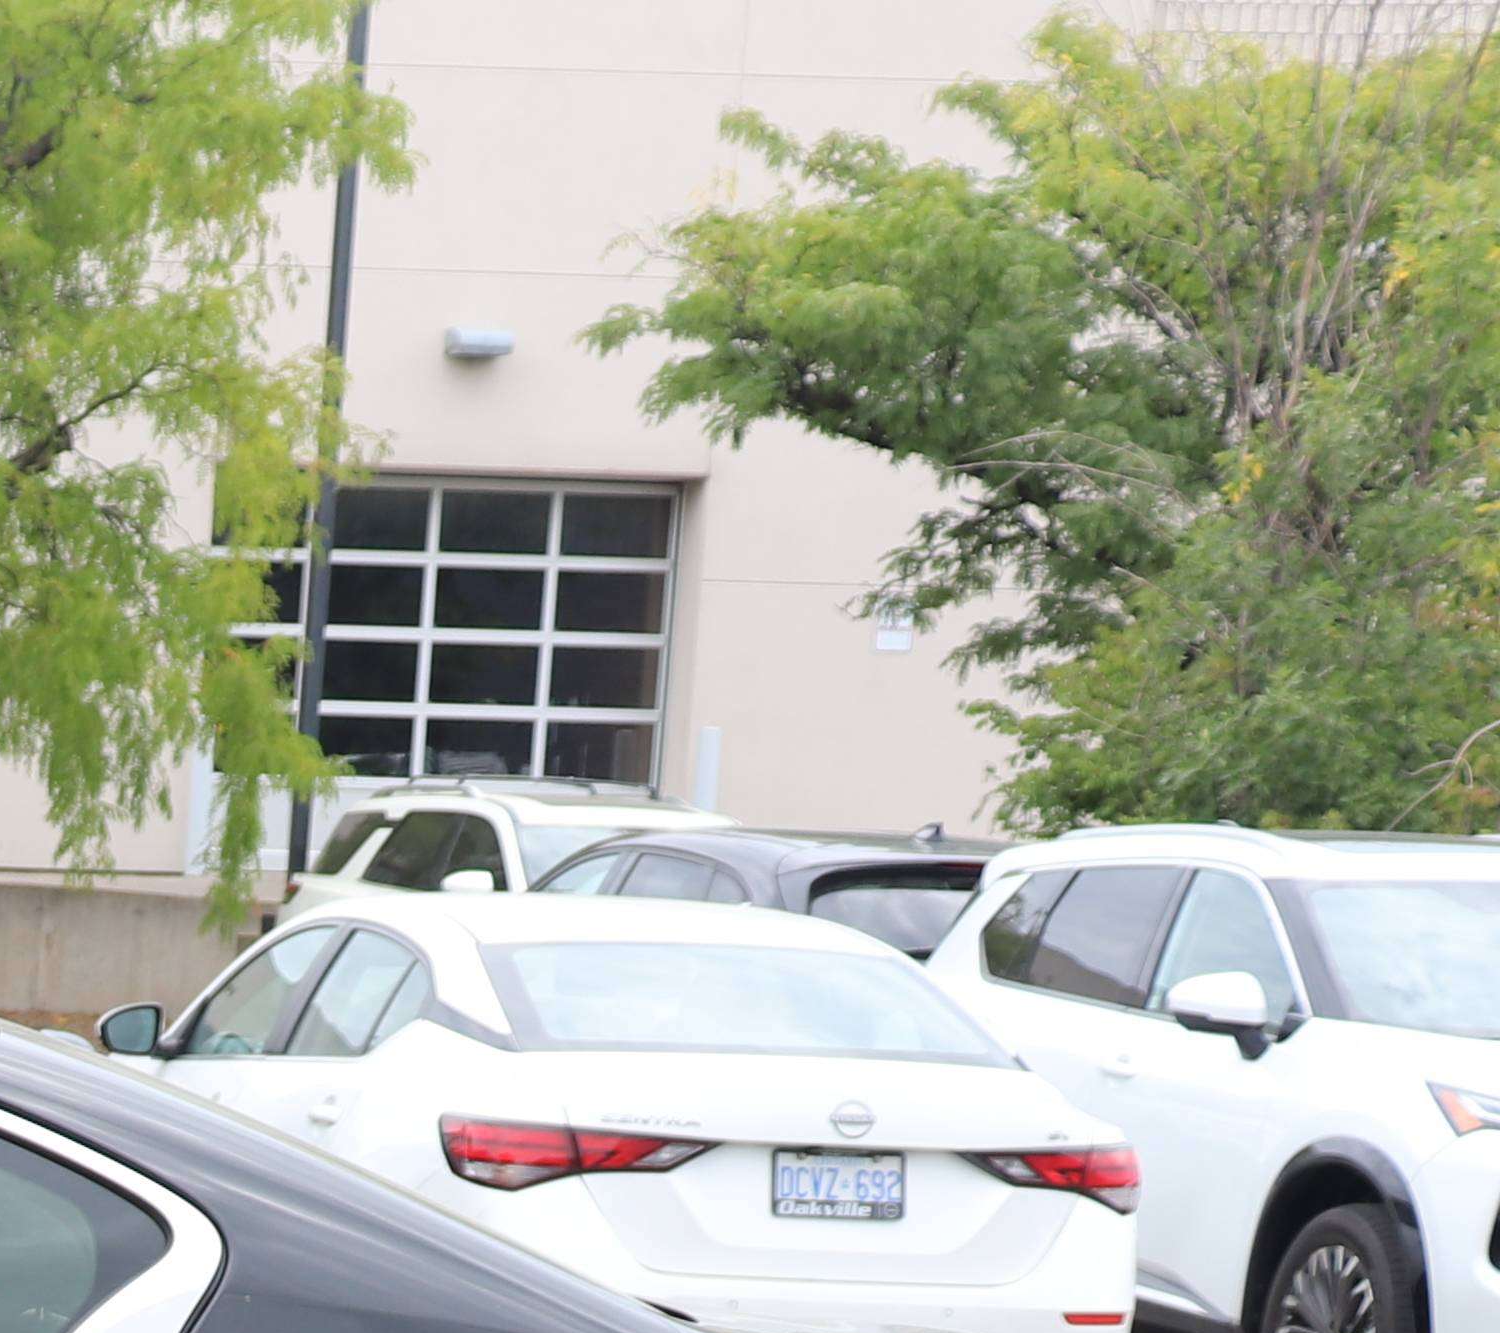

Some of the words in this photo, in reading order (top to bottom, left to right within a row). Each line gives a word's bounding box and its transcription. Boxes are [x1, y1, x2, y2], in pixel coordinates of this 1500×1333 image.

[780, 1165, 840, 1200] DCVZ
[855, 1168, 902, 1201] 692
[778, 1199, 873, 1218] Oakville
